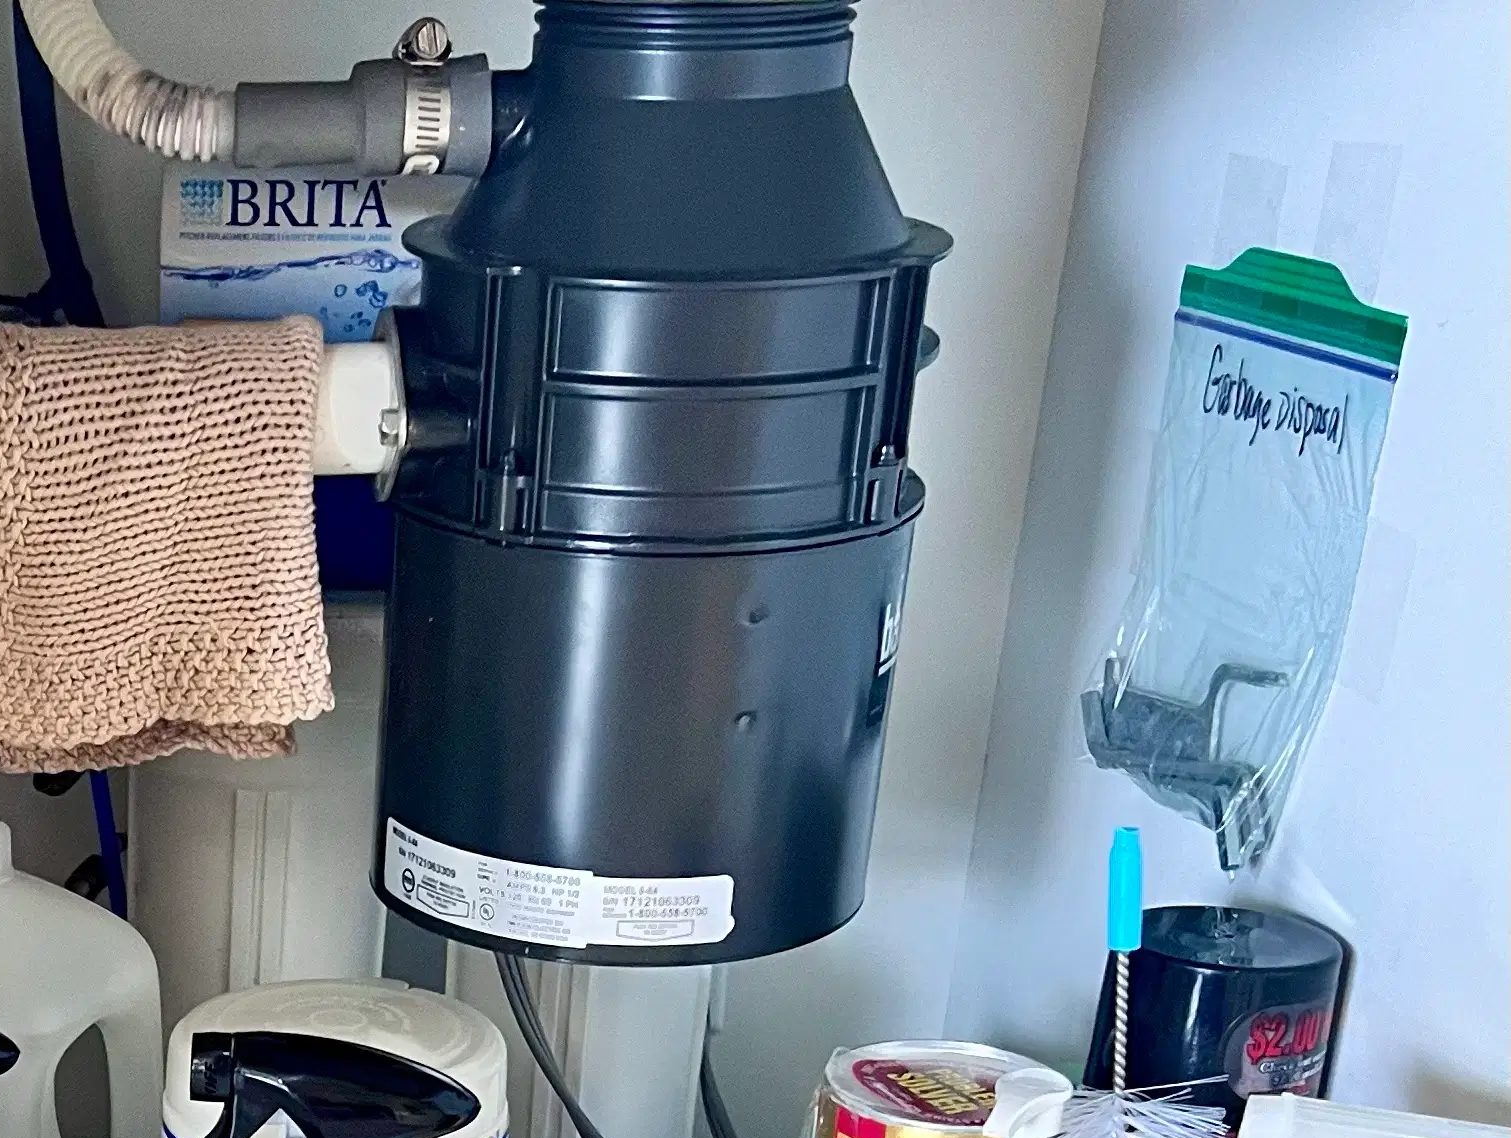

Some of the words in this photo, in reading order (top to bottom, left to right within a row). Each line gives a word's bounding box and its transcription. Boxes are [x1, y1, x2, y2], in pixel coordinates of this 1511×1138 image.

[226, 179, 391, 228] BRITA
[1202, 344, 1271, 446] Garbage
[1274, 387, 1349, 457] Disposal
